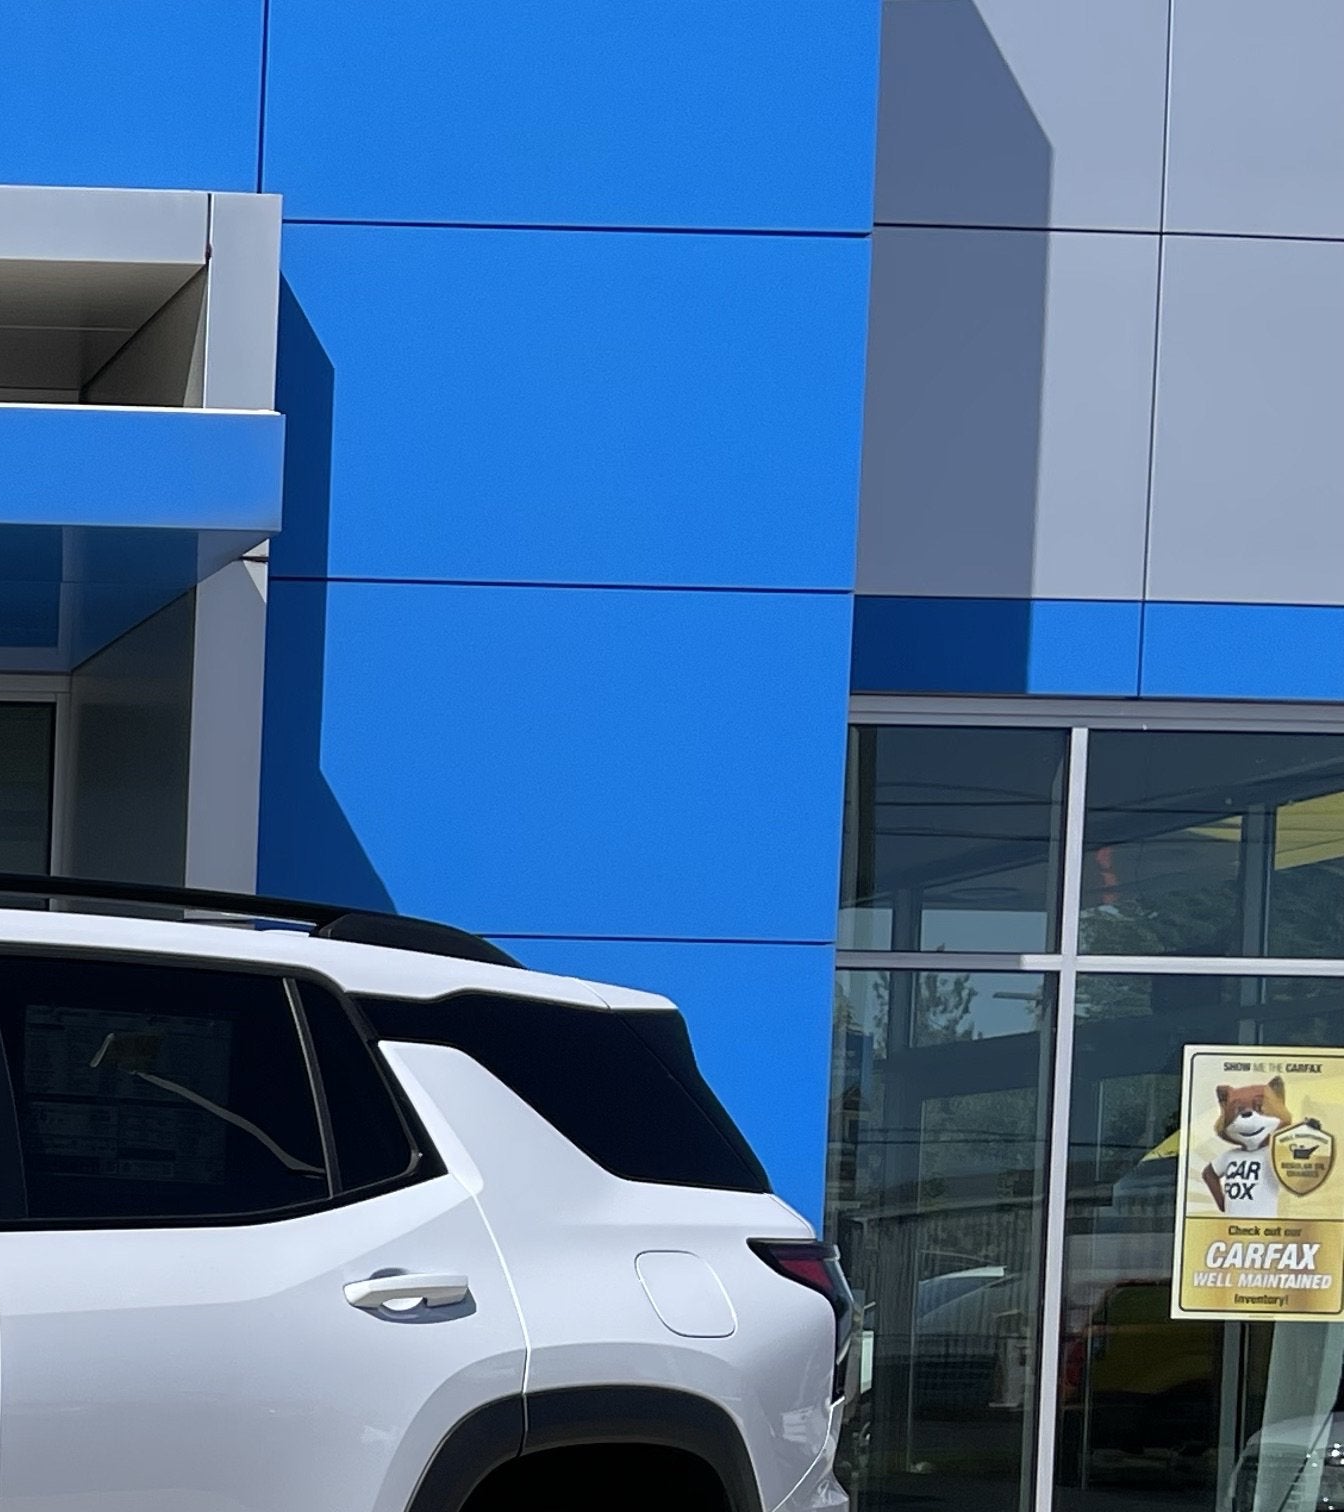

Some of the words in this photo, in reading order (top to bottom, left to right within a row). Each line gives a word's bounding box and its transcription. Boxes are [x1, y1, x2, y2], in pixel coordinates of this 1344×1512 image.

[1224, 1062, 1251, 1072] SHOW
[1285, 1064, 1322, 1074] CARFAX
[1226, 1161, 1261, 1180] CAR
[1228, 1225, 1261, 1236] Check
[1264, 1226, 1282, 1236] out
[1284, 1227, 1302, 1236] our
[1206, 1241, 1321, 1270] CARFAX
[1193, 1272, 1232, 1287] WELL
[1237, 1272, 1333, 1289] MAINTAINED
